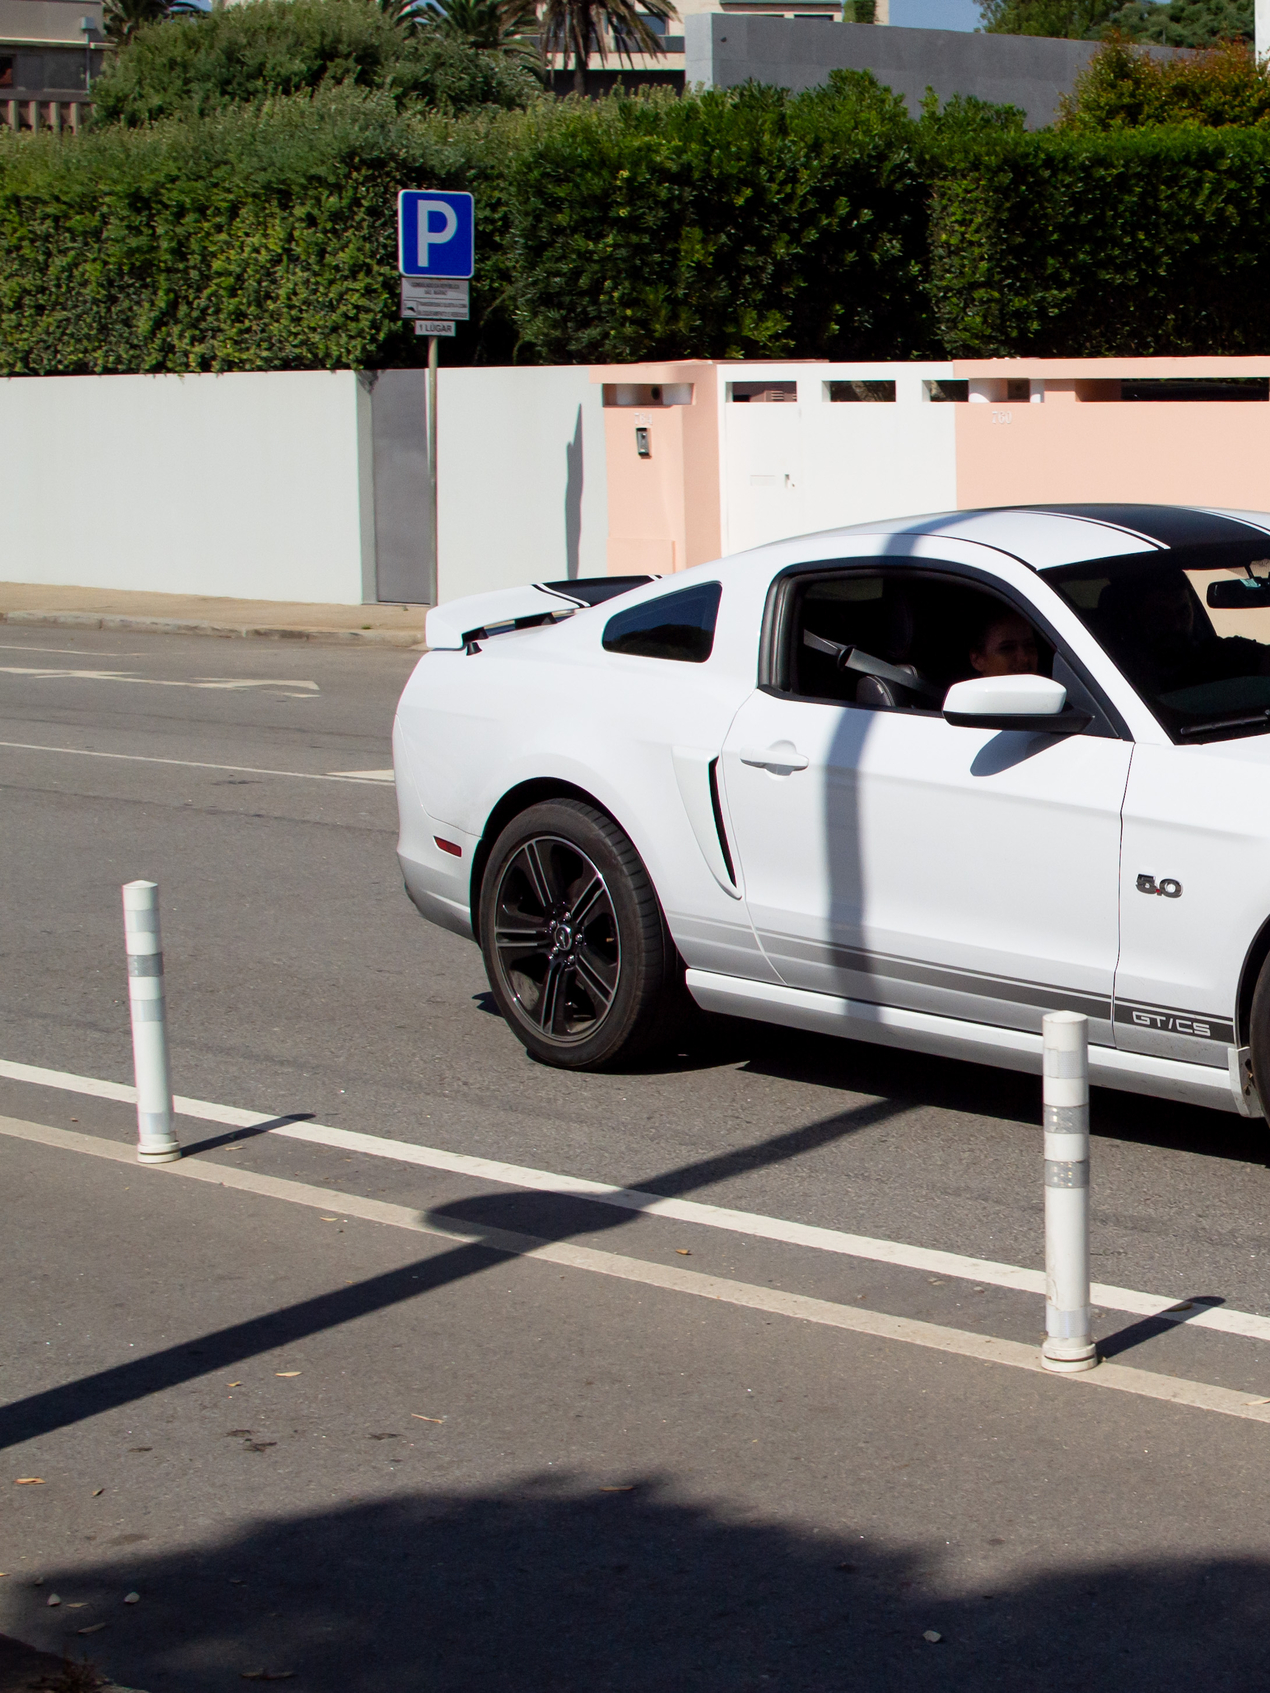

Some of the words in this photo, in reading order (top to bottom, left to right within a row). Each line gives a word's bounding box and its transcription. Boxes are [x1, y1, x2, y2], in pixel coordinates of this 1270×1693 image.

[417, 199, 458, 268] P
[425, 324, 452, 333] LUGAR
[992, 411, 1013, 425] 760
[1135, 873, 1184, 899] 5.0
[1132, 1010, 1211, 1037] GT/CS
